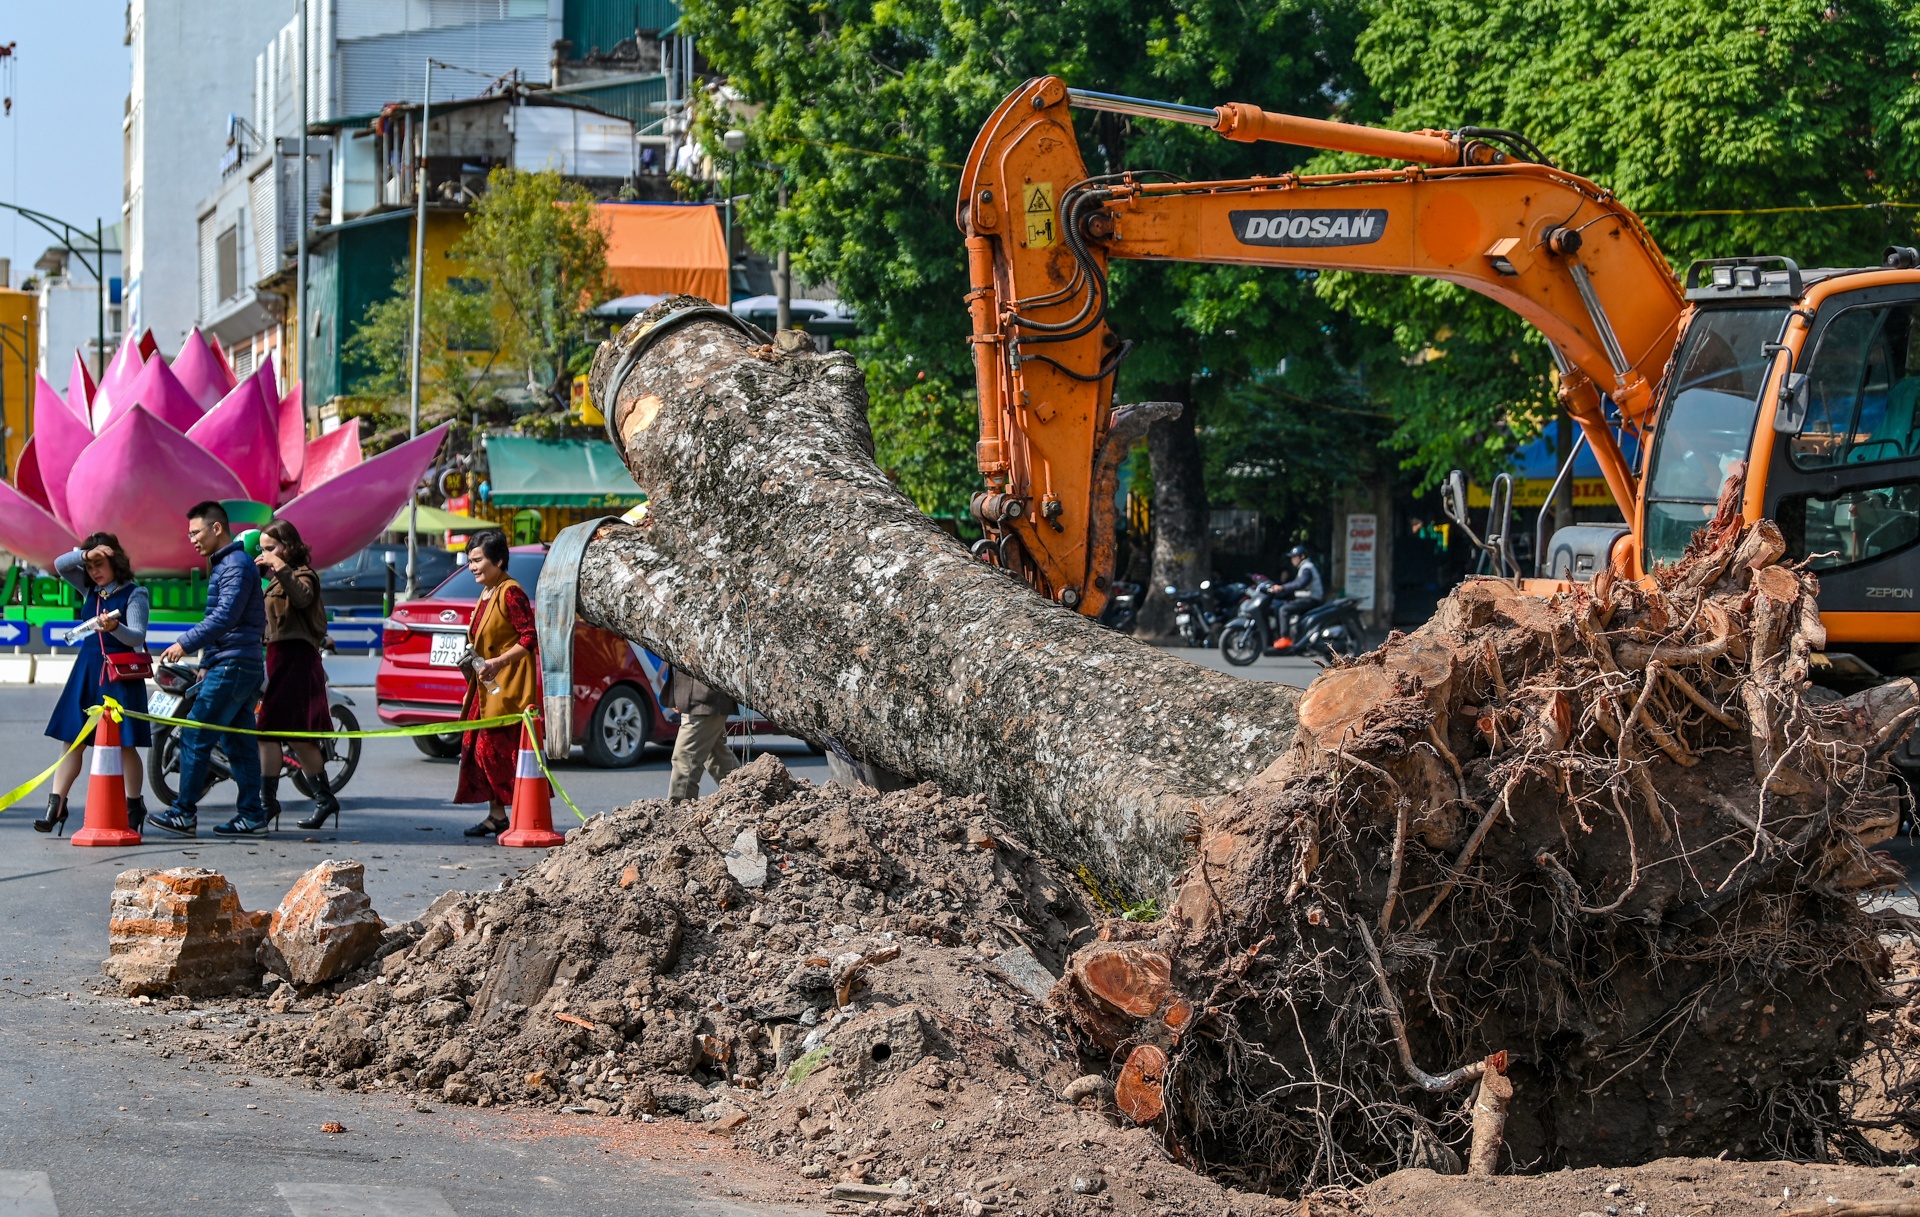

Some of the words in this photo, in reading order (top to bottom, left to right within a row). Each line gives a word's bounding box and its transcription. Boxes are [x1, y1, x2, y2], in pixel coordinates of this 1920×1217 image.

[1244, 216, 1375, 239] DOOSAN
[1867, 587, 1914, 598] ZEPION
[439, 636, 458, 649] 30G
[171, 816, 183, 827] N
[234, 821, 247, 831] N
